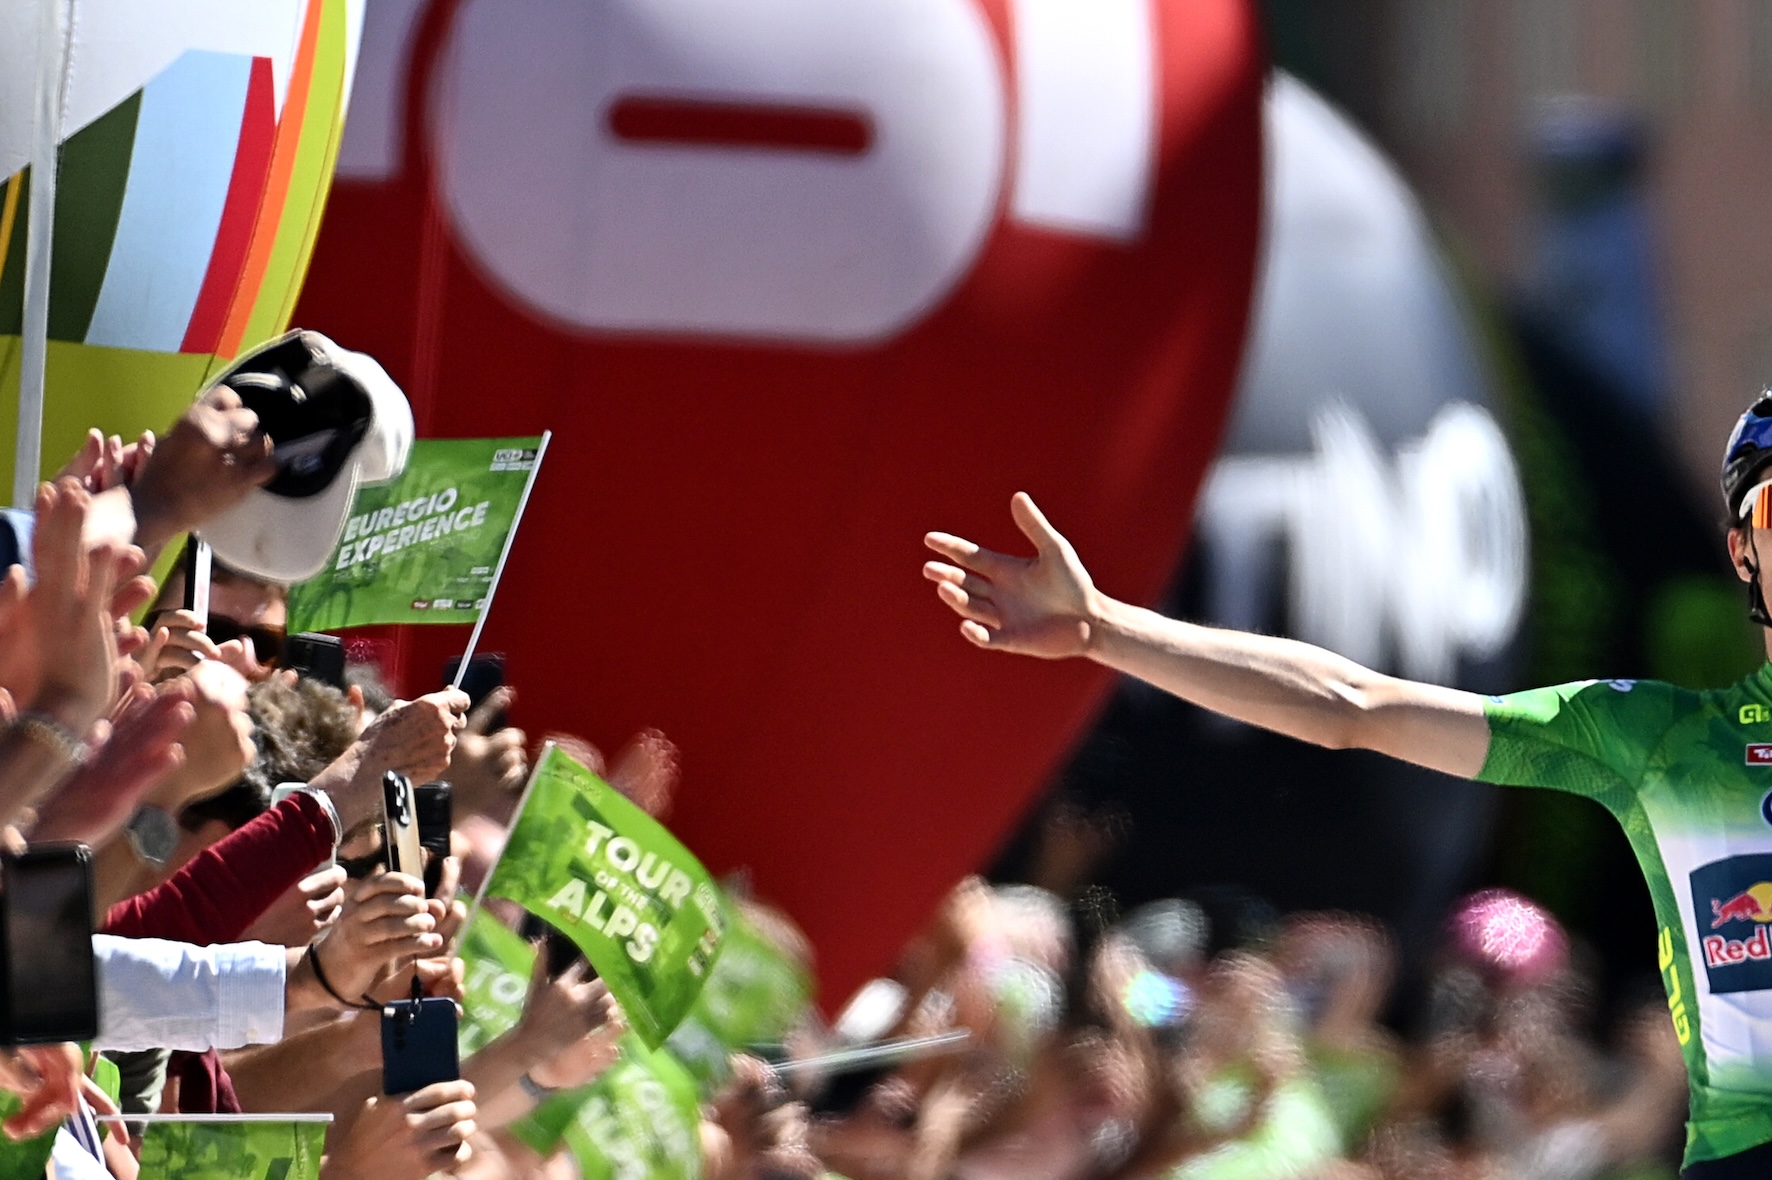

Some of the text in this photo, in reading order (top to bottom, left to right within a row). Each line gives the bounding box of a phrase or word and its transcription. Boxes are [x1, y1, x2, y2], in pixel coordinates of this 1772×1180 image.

[335, 500, 490, 570] EXPERIENCE
[343, 487, 458, 543] EUREGIO
[586, 820, 693, 910] TOUR
[545, 877, 659, 963] ALPS
[1704, 924, 1771, 968] Red
